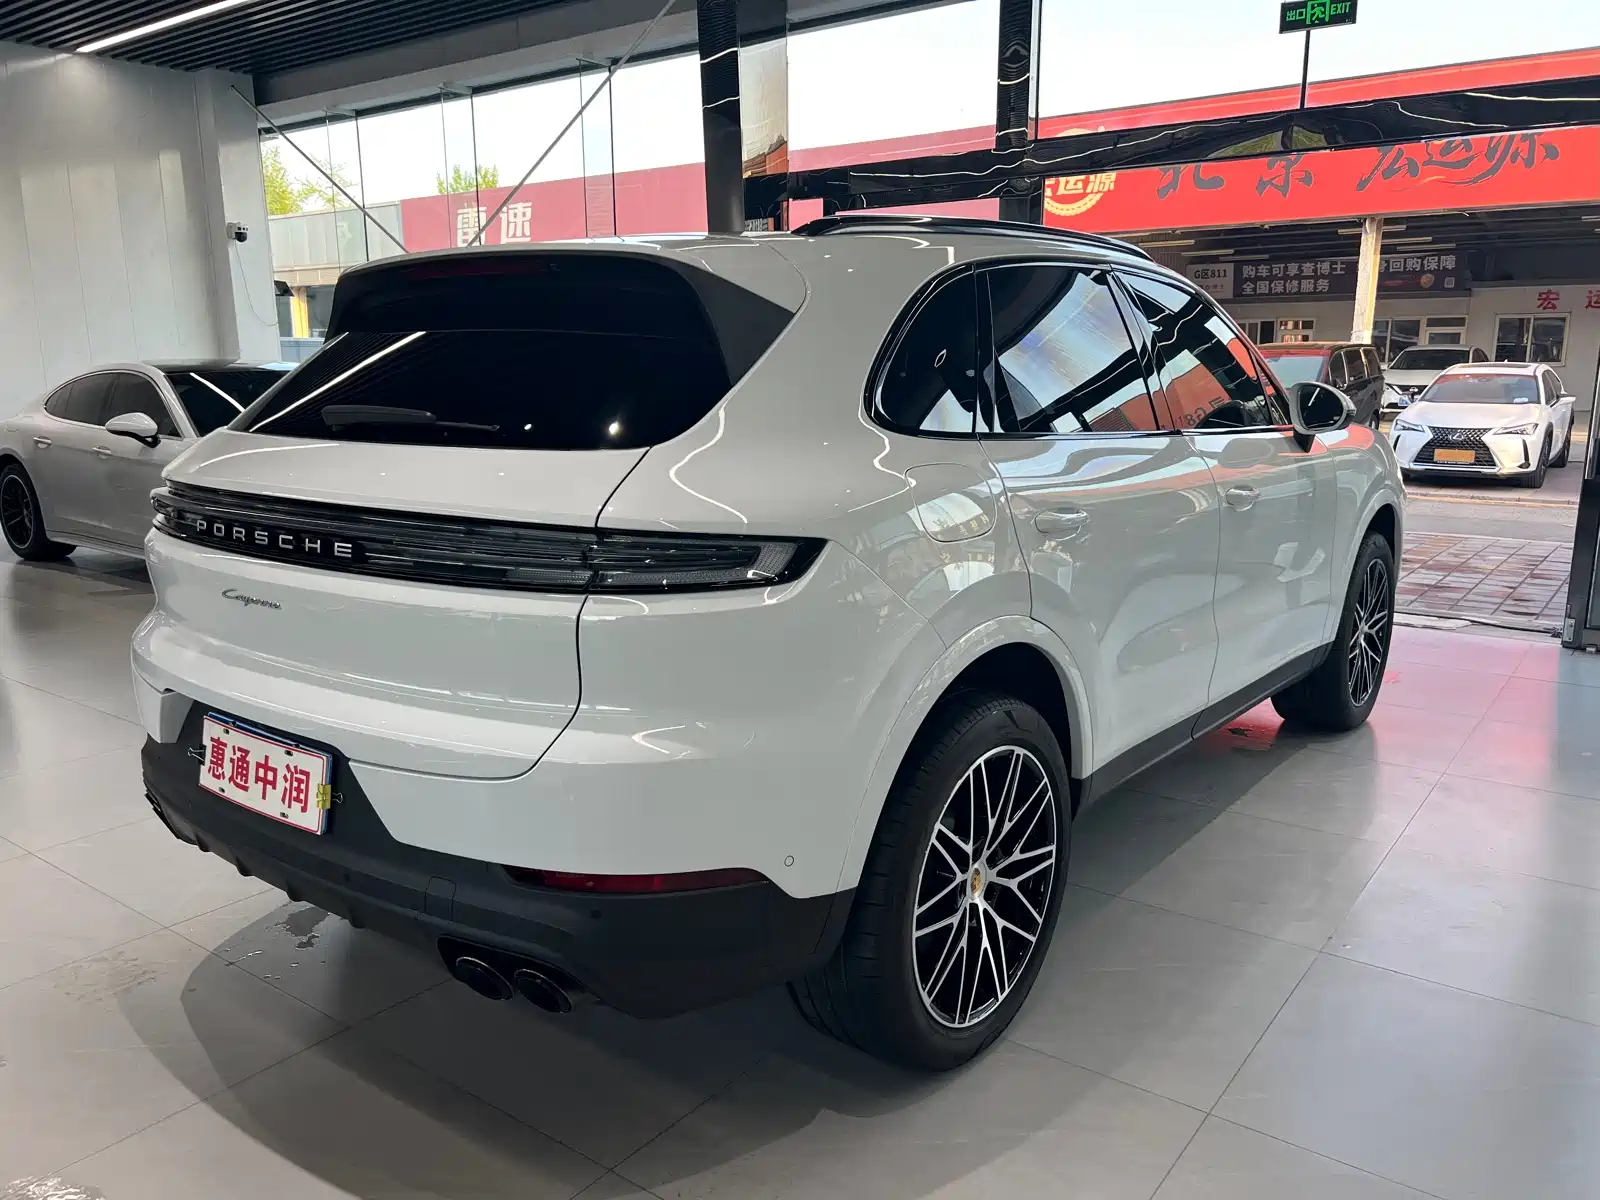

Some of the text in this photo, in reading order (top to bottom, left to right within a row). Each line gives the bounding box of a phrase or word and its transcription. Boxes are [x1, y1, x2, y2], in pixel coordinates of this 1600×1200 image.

[1286, 8, 1306, 21] 出口
[1330, 2, 1351, 15] EXIT
[1193, 268, 1228, 280] G区811
[1242, 261, 1346, 278] 购车可享查博士
[1242, 279, 1330, 295] 全国保修服务
[196, 519, 353, 557] PORSCHE
[221, 588, 283, 610] Cayenne
[207, 736, 312, 814] 惠通中润
